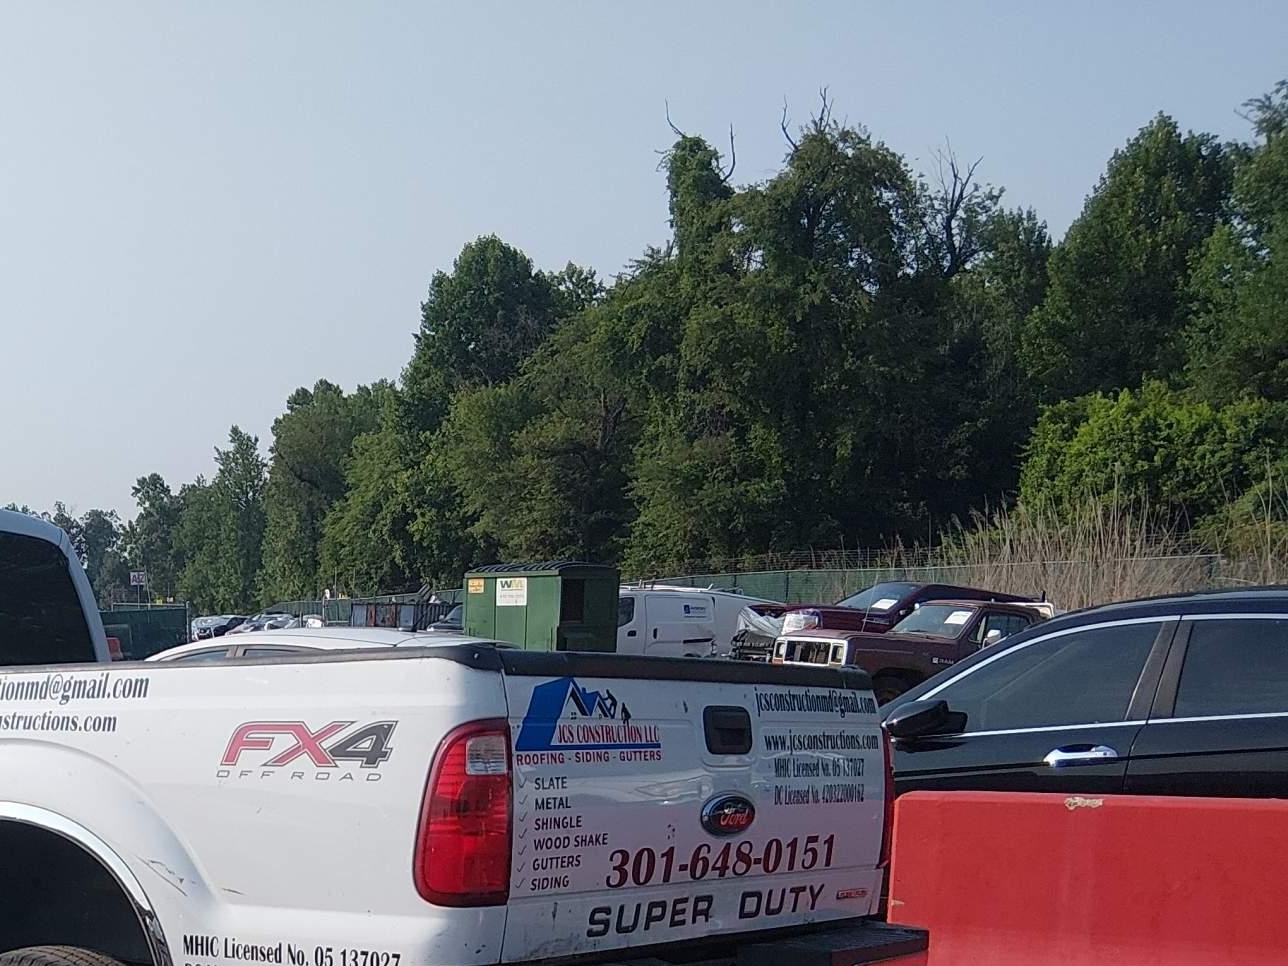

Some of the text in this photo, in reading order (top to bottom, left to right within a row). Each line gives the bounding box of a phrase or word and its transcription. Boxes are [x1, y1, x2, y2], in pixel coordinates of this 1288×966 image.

[754, 686, 877, 718] jcsconstructionmd@gmail.com
[557, 724, 660, 744] JCS CONSTRUCTION LLC
[764, 729, 879, 755] www.jcsconstructions.com
[220, 720, 399, 769] FX4
[516, 752, 565, 766] ROOFING
[574, 751, 610, 763] SIDING
[619, 750, 662, 762] GUTTERS
[216, 769, 383, 782] OFF ROAD
[774, 758, 792, 778] MHIC
[792, 758, 820, 778] Licensed
[534, 776, 568, 790] SLATE
[534, 797, 572, 811] METAL
[774, 785, 784, 805] DC
[784, 785, 811, 805] Licensed
[534, 816, 583, 831] SHINGLE
[720, 808, 749, 826] Ford
[533, 833, 609, 851] WOOD SHAKE
[532, 855, 582, 871] GUTTERS
[605, 834, 835, 889] 301-648-0151
[530, 876, 570, 891] SIDING
[586, 883, 826, 938] SUPER DUTY
[183, 934, 219, 958] MHIC
[224, 937, 282, 964] Licensed
[287, 943, 309, 966] No.
